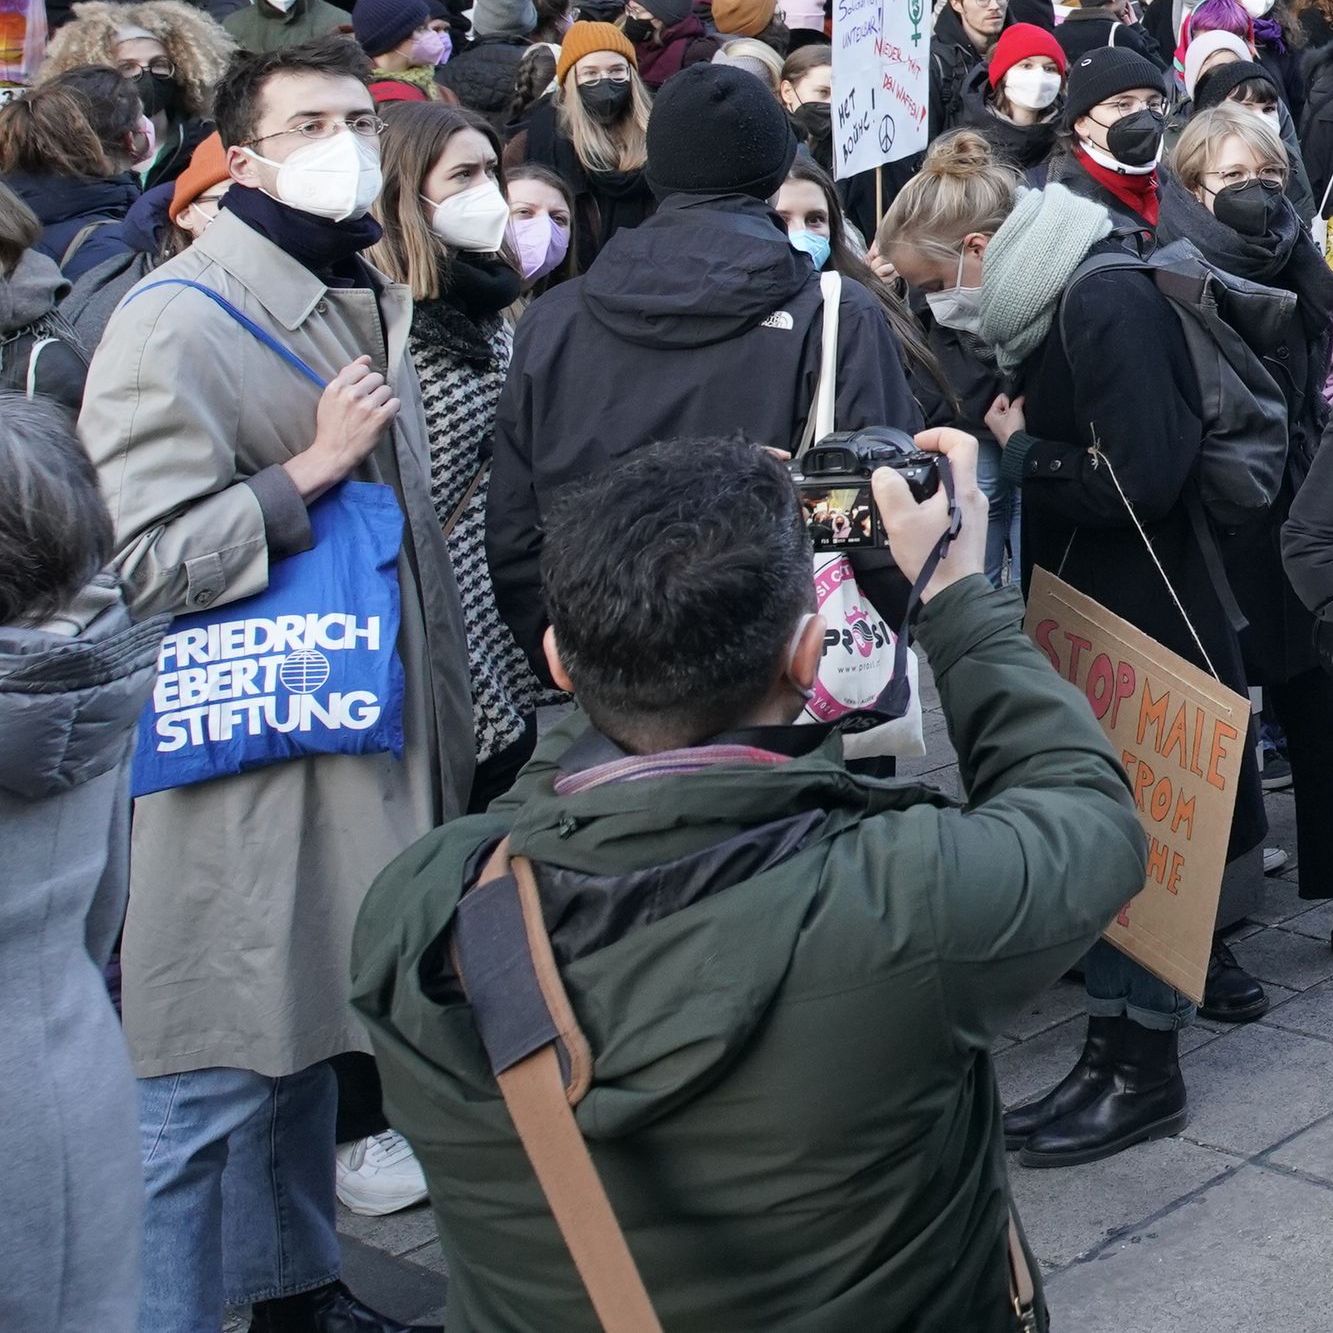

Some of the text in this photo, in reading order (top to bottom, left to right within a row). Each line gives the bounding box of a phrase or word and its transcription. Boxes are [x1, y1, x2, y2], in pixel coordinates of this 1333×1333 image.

[158, 613, 380, 672] FRIEDRICH
[152, 655, 287, 714] EBERT
[1035, 619, 1239, 792] STOP MALE
[156, 690, 381, 753] STIFTUNG
